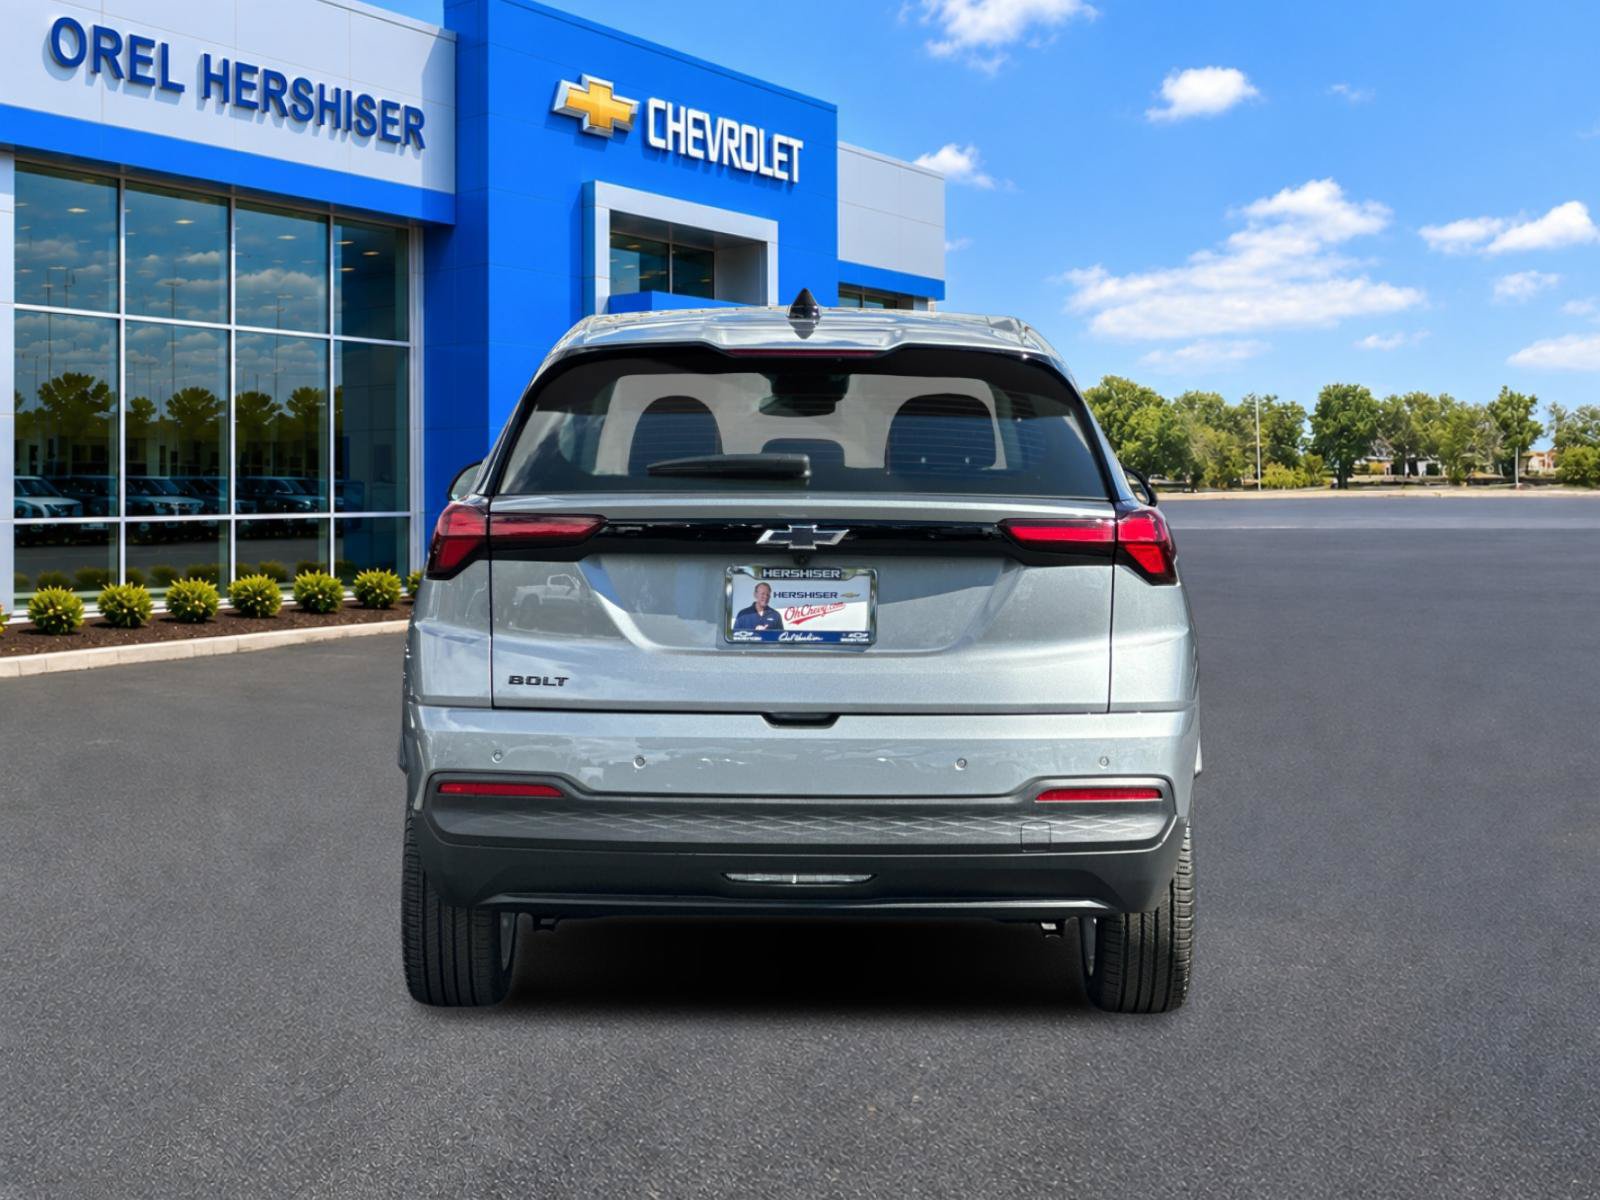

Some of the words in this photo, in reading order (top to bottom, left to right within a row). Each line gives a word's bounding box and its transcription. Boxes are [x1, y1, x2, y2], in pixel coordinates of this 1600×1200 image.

[49, 16, 185, 95] OREL
[200, 53, 426, 150] HERSHISER
[647, 97, 804, 183] CHEVROLET
[762, 568, 841, 578] HERSHISER
[773, 591, 839, 599] HERSHISER
[508, 675, 569, 687] BOLT
